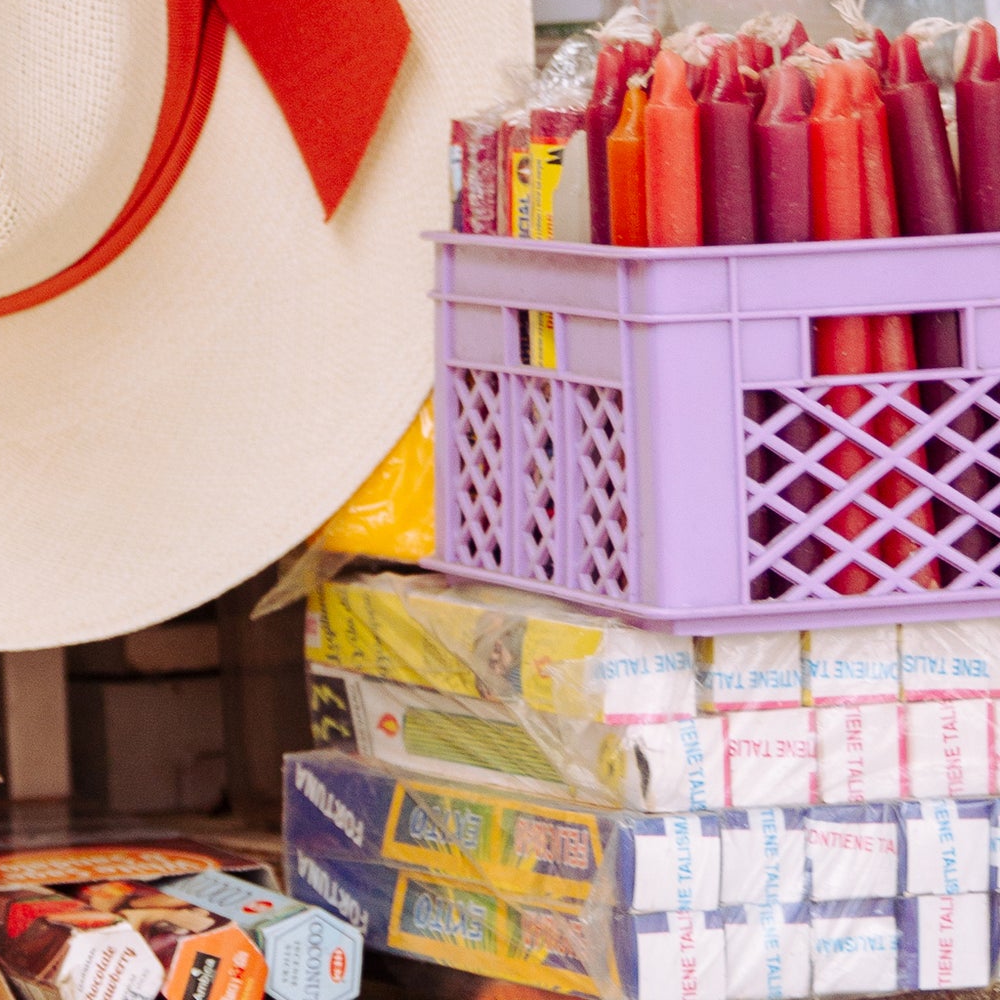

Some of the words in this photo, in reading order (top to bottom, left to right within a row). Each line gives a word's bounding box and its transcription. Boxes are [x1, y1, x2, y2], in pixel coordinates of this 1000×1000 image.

[760, 808, 779, 857] TIENE
[85, 945, 116, 1000] hocolate
[938, 938, 953, 987] TIENE
